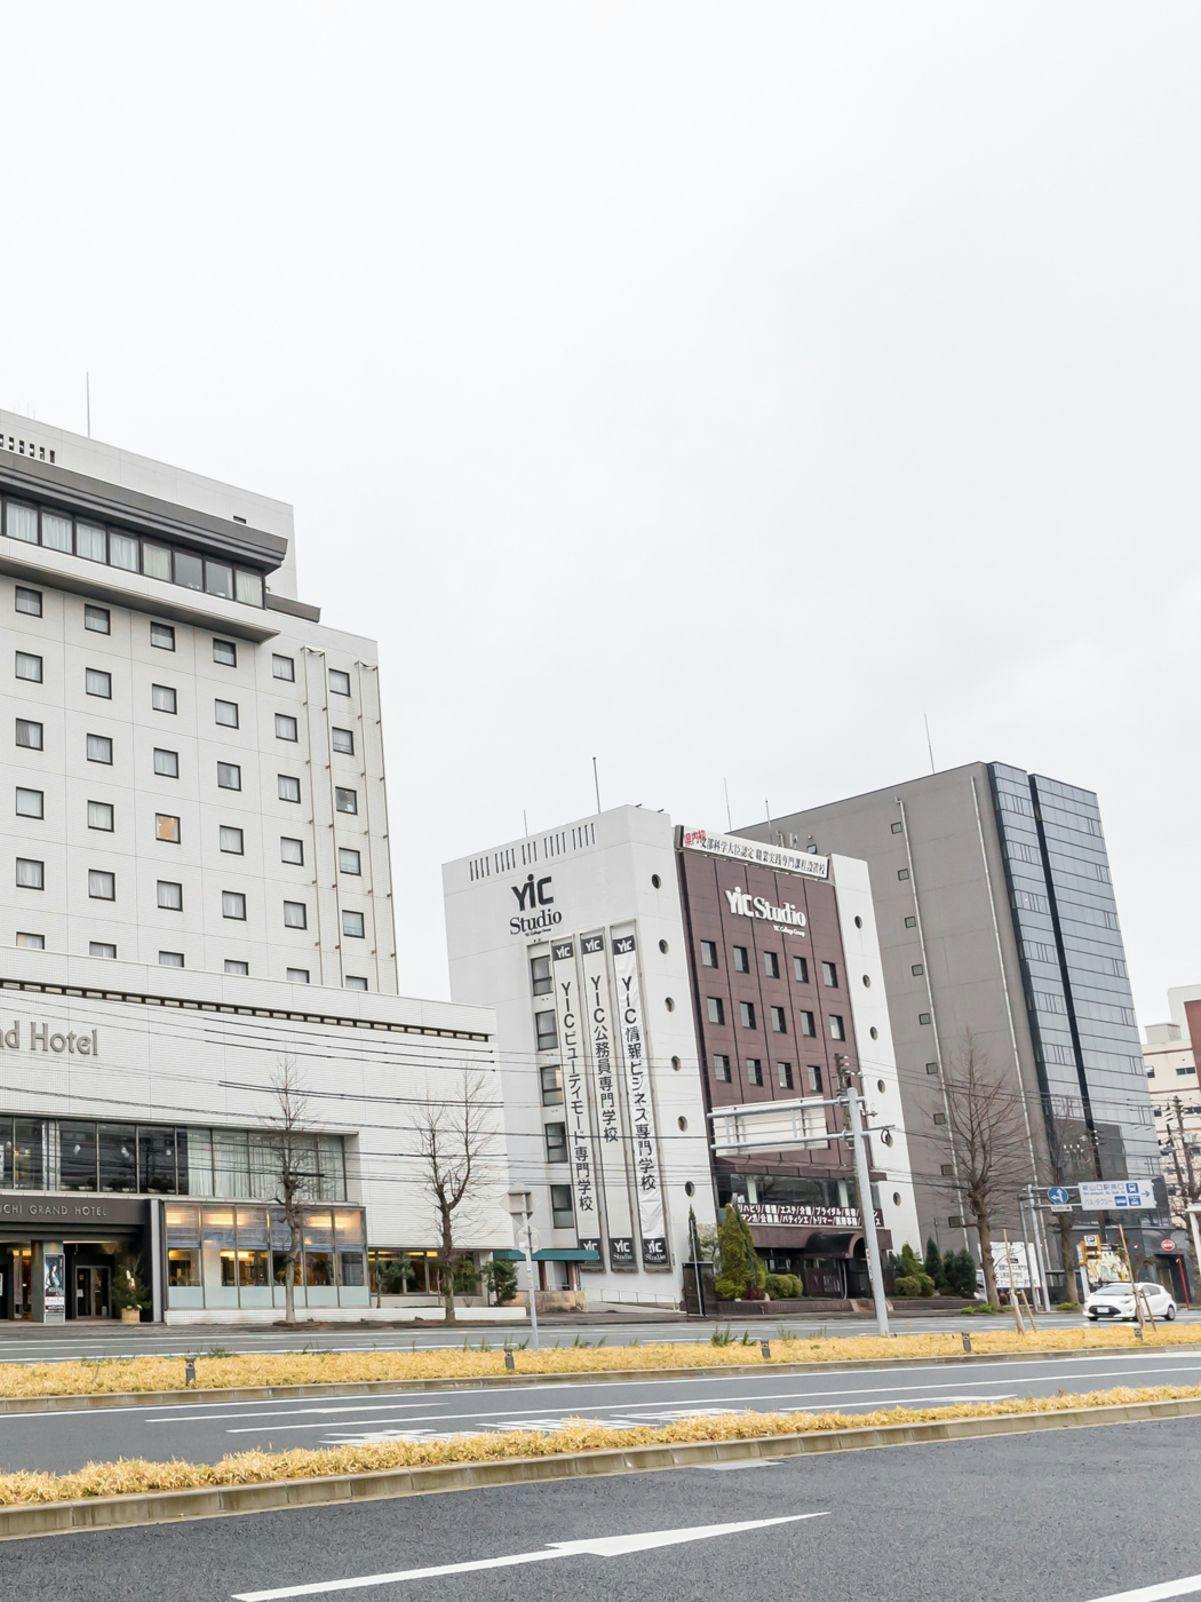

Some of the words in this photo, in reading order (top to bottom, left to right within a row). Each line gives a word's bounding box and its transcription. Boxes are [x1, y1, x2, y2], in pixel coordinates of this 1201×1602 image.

[509, 909, 562, 935] Studio
[754, 897, 806, 927] Studio
[30, 1021, 99, 1056] Hotel
[590, 976, 618, 1142] YIC公務員専門学校
[561, 981, 594, 1211] YICビューティモード専門学校
[622, 976, 656, 1191] YIC情報ビジネス専門学校
[29, 1204, 68, 1215] GRAND
[74, 1206, 107, 1216] HOTEL
